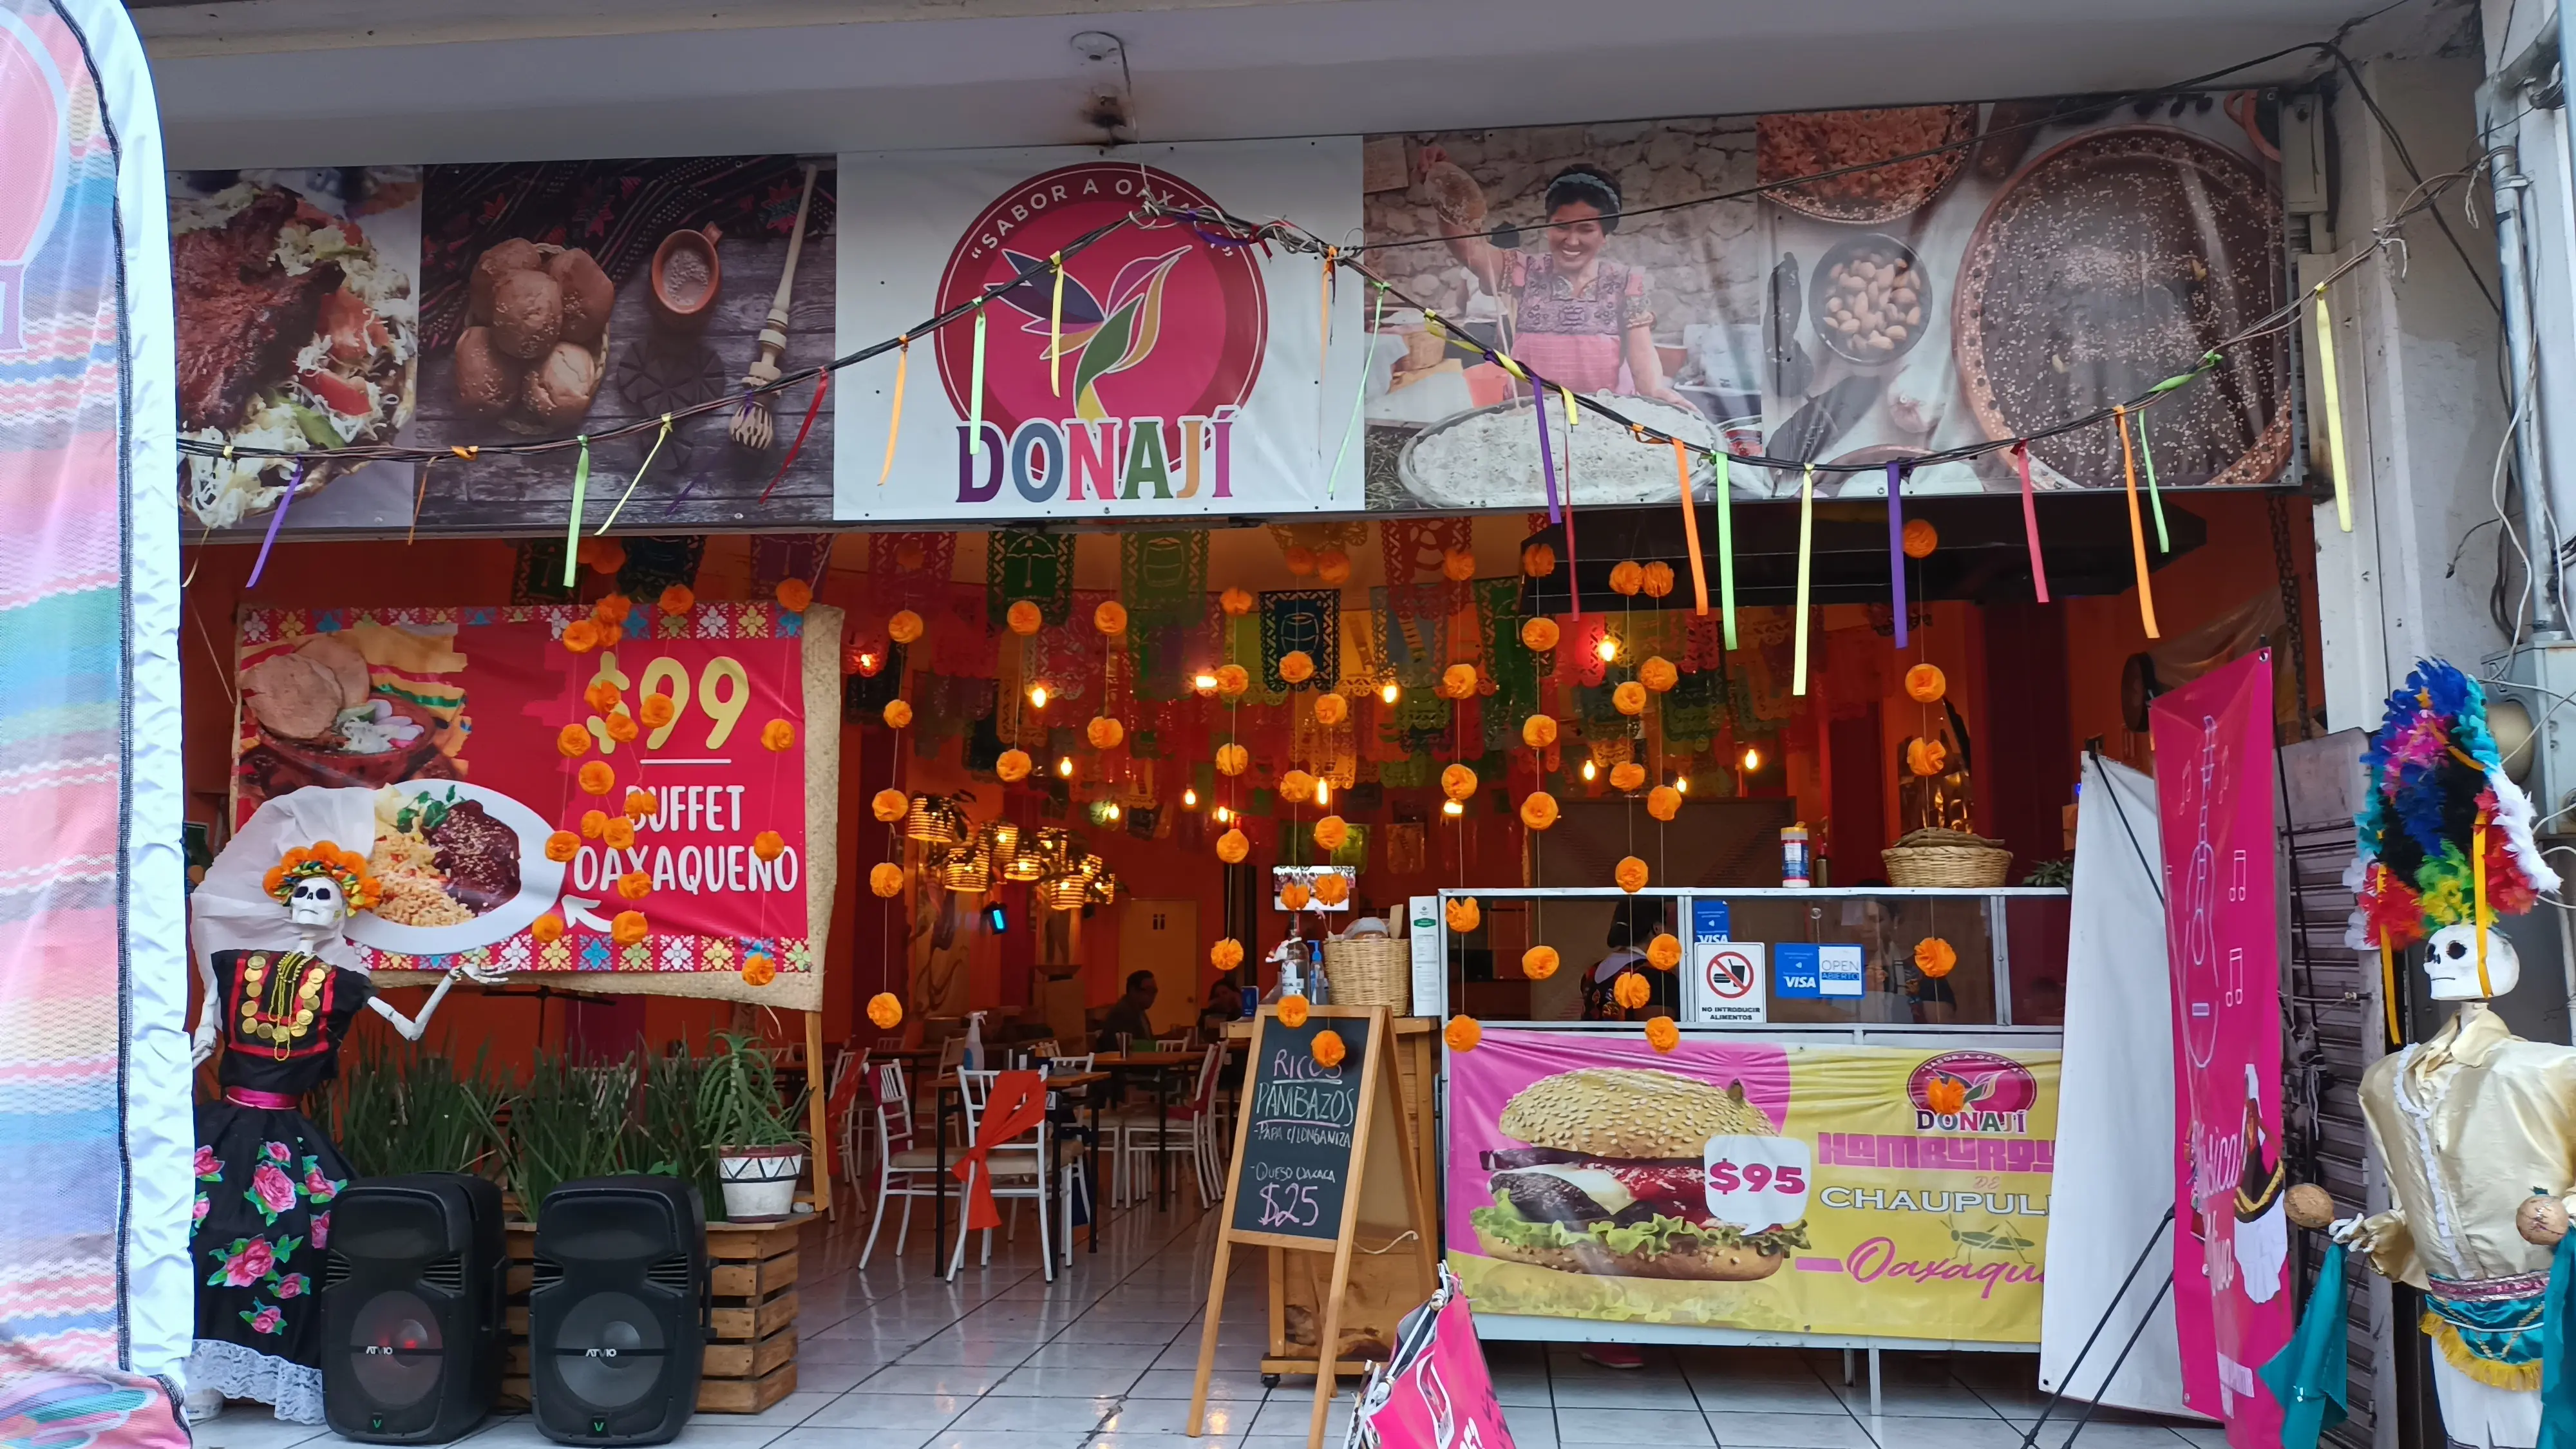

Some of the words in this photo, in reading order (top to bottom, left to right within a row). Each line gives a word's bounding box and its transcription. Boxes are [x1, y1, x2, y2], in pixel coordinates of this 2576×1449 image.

[1083, 178, 1099, 194] A
[956, 408, 1237, 503] DONAJÍ
[587, 650, 749, 754] $99
[1696, 934, 1728, 942] VISA
[1821, 960, 1859, 971] OPEN
[1783, 976, 1816, 988] VISA
[1256, 1082, 1354, 1127] PAMBAZOS
[1709, 1158, 1806, 1195] $95
[1973, 1175, 2000, 1189] DE
[1258, 1182, 1319, 1227] $25
